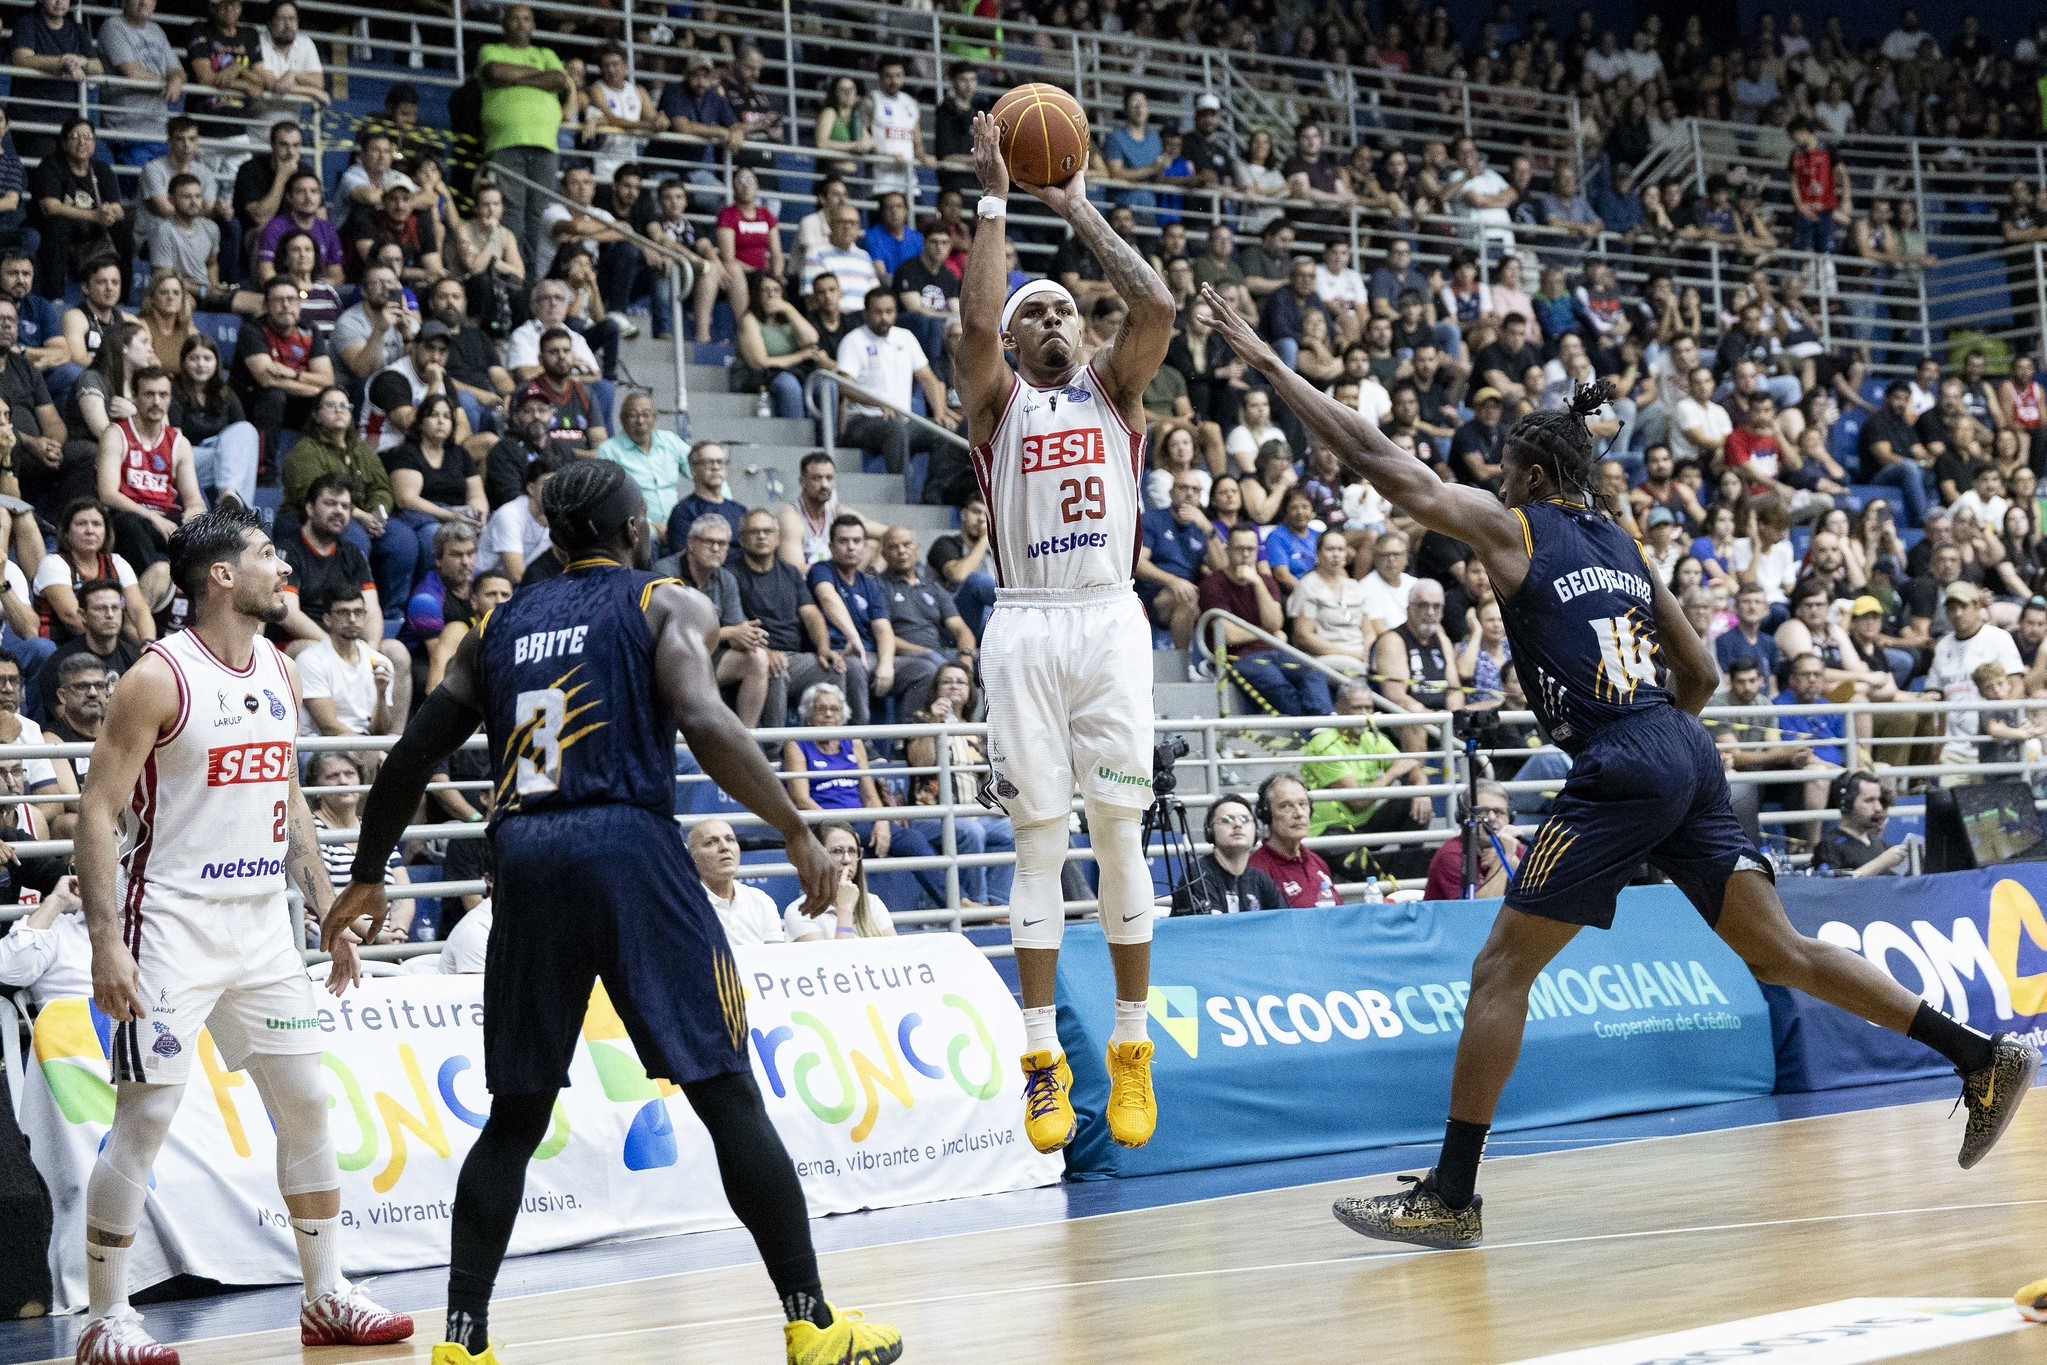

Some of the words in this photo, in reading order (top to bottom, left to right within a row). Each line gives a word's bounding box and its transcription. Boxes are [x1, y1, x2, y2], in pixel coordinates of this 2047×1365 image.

[1022, 432, 1096, 470] SESI
[1059, 476, 1107, 524] 29
[514, 625, 589, 665] BRITE
[515, 688, 567, 795] 3
[200, 857, 286, 880] Netshoe
[753, 962, 936, 1000] Prefeitura
[266, 1016, 320, 1030] Unime
[317, 998, 484, 1033] efeitura
[1593, 1015, 1675, 1040] Cooperativa
[1675, 1012, 1694, 1031] de
[1693, 1011, 1741, 1030] Crédito
[791, 1157, 842, 1178] erna,
[846, 1147, 920, 1172] vibrante
[925, 1145, 936, 1160] e
[941, 1129, 1016, 1157] inclusiva.
